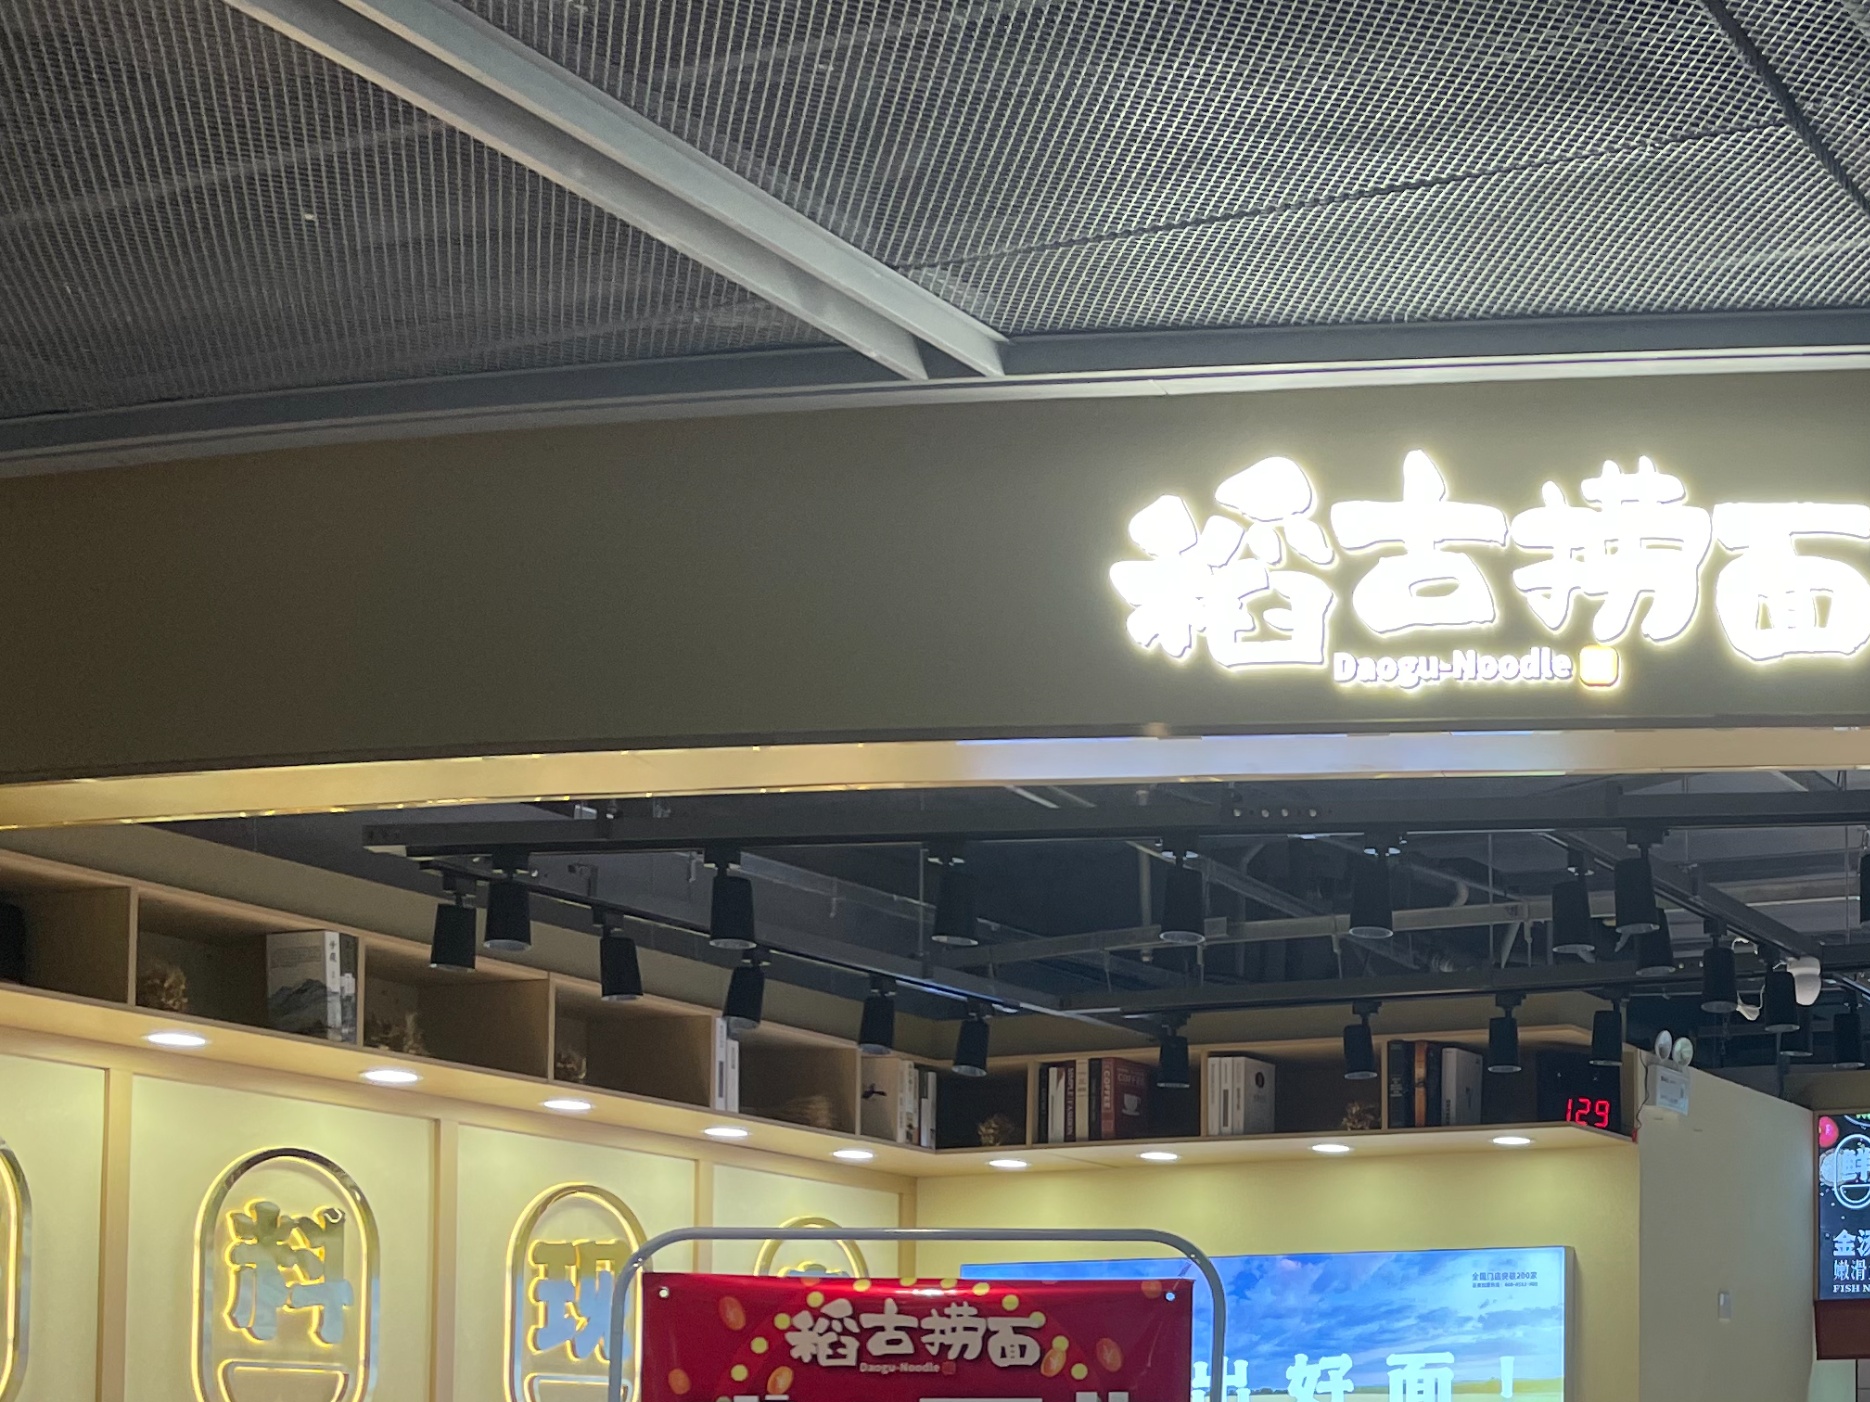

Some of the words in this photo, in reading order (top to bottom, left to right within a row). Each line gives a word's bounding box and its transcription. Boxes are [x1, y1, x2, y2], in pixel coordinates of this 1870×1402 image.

[1332, 646, 1573, 691] Daogu-Noodle
[1565, 1098, 1611, 1129] 129
[1832, 1284, 1860, 1293] FISH
[784, 1298, 1044, 1367] 稻古捞面
